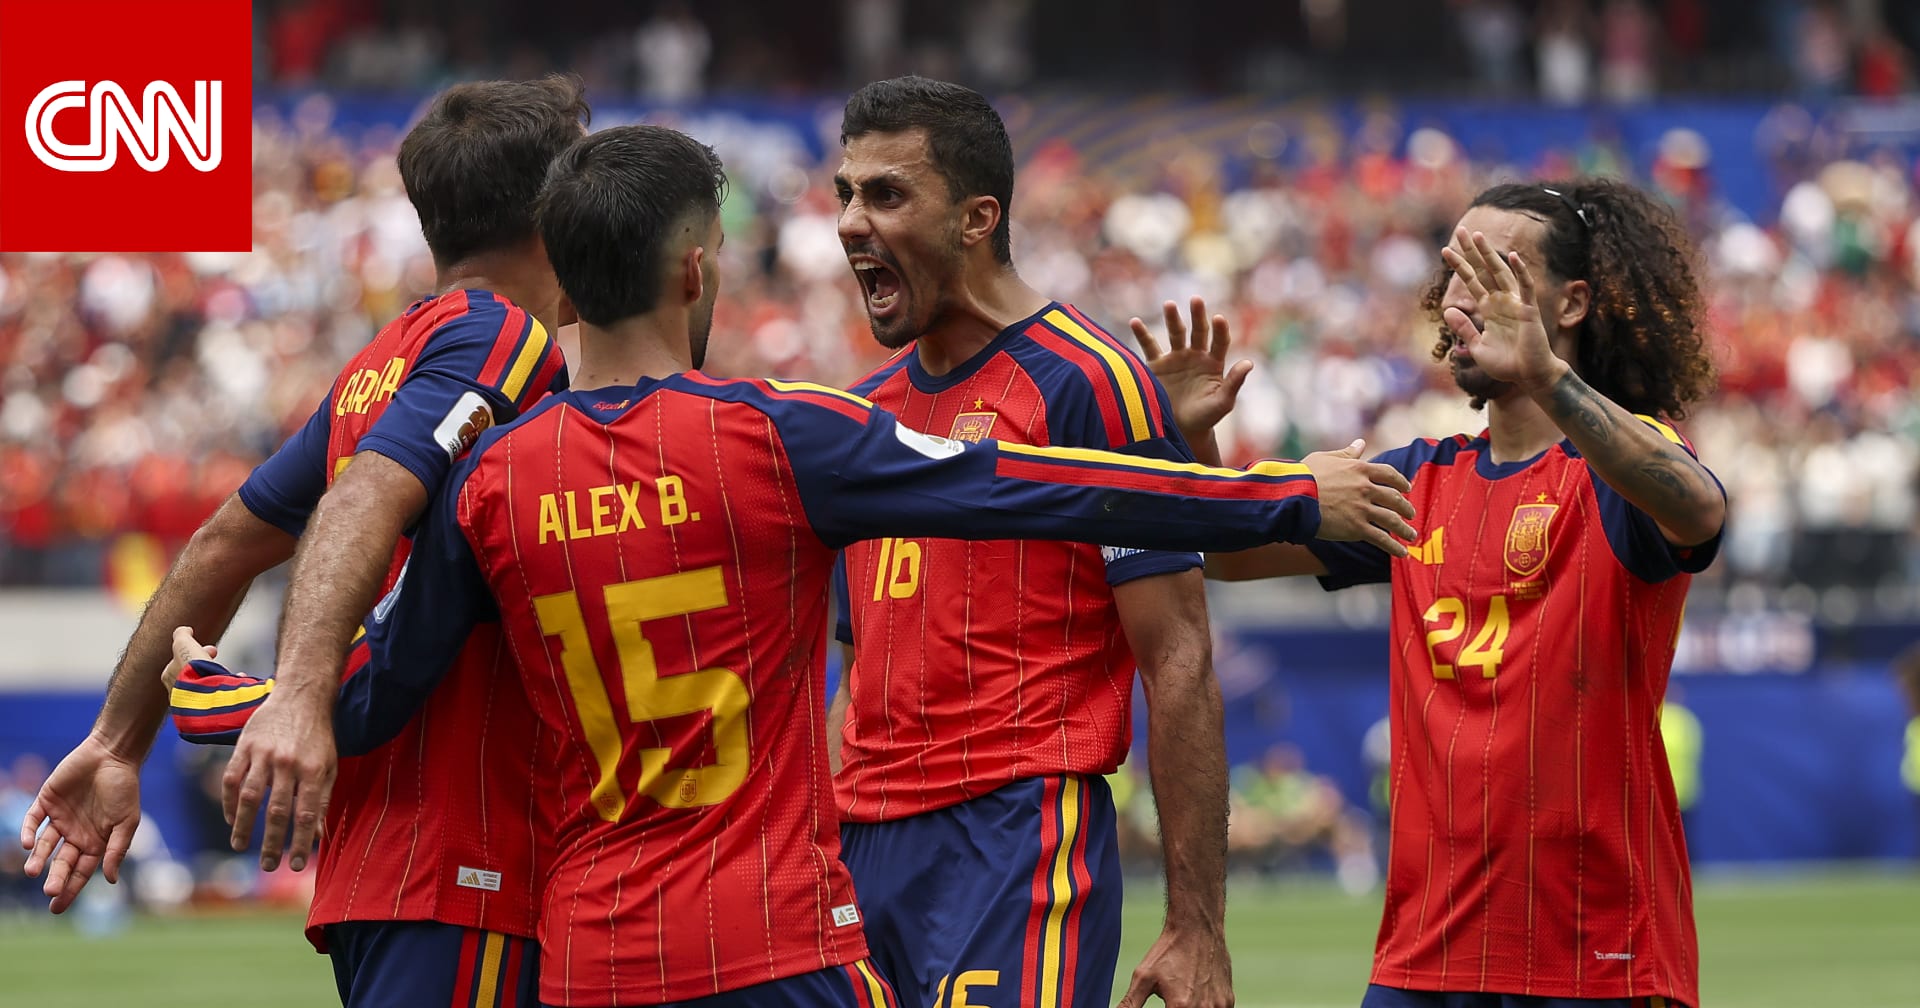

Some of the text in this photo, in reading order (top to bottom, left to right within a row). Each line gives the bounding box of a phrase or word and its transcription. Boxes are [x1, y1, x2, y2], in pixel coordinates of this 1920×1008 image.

[539, 475, 701, 545] ALEX B.
[873, 537, 921, 602] 16
[1423, 594, 1510, 679] 24
[532, 565, 750, 824] 15
